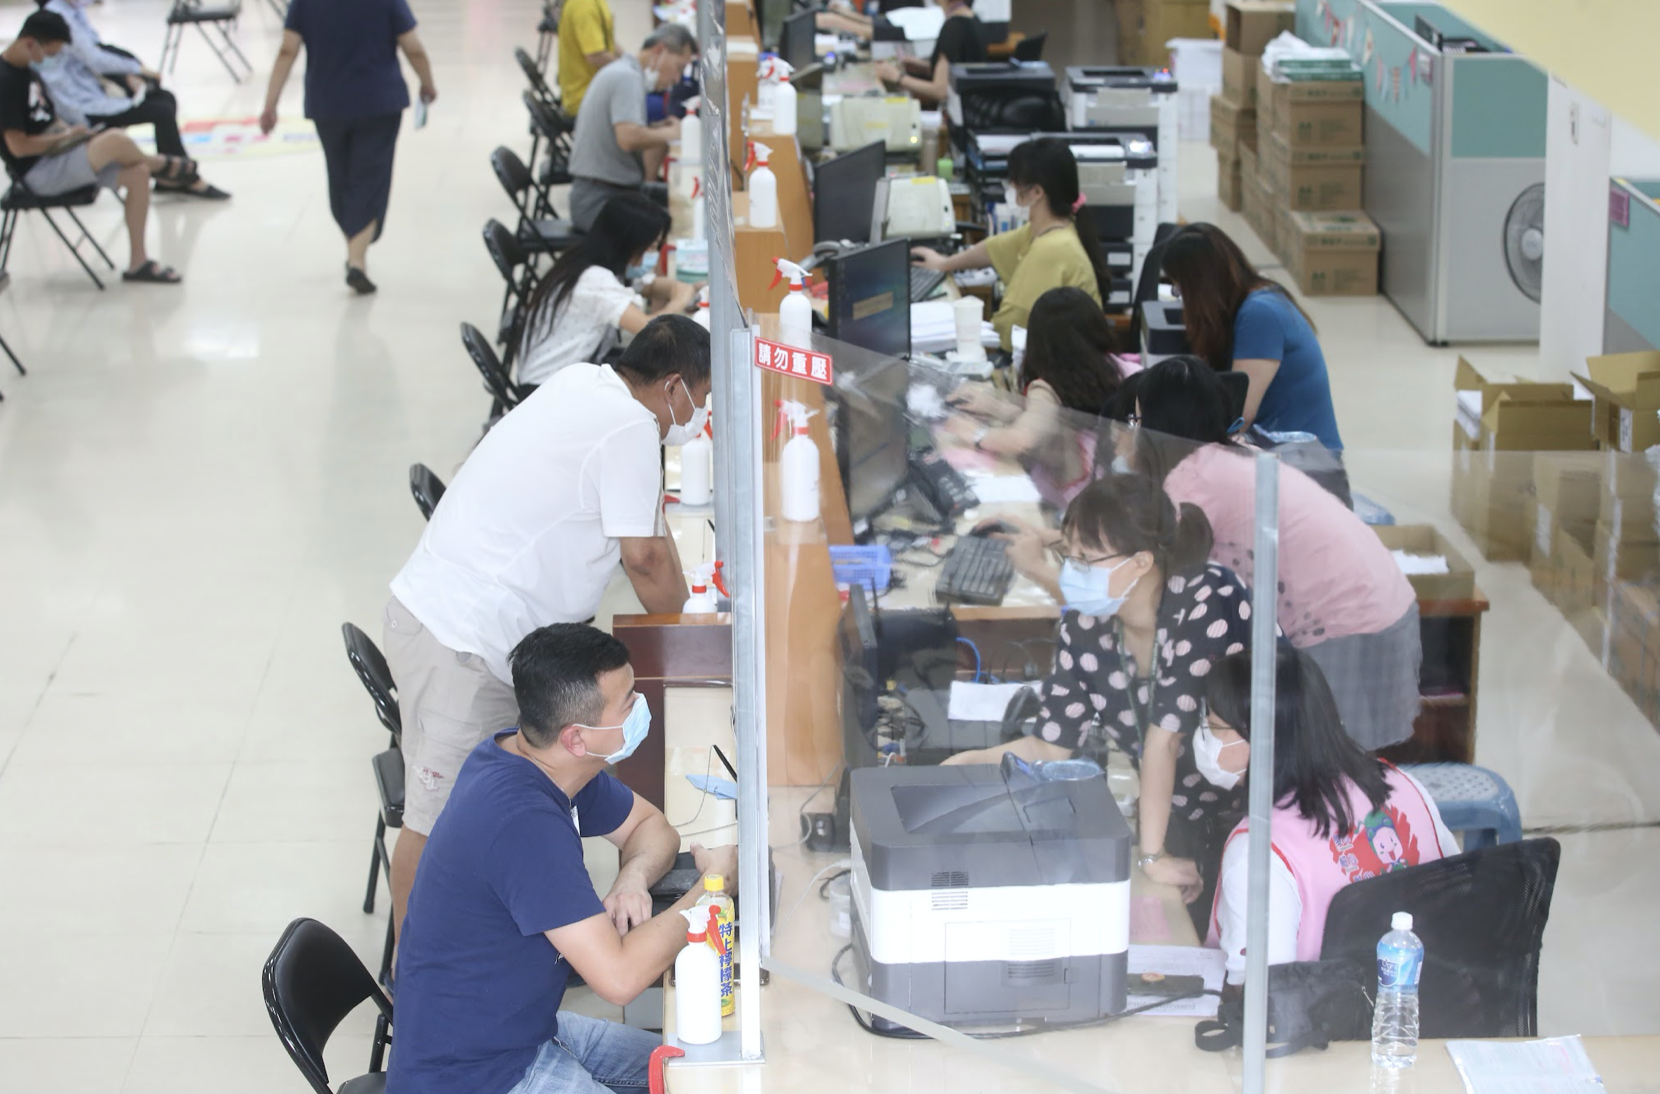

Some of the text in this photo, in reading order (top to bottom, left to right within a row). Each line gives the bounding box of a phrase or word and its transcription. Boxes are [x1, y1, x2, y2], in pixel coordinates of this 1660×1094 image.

[757, 341, 828, 380] 請勿重壓
[718, 921, 733, 998] 特上檸檬茶
